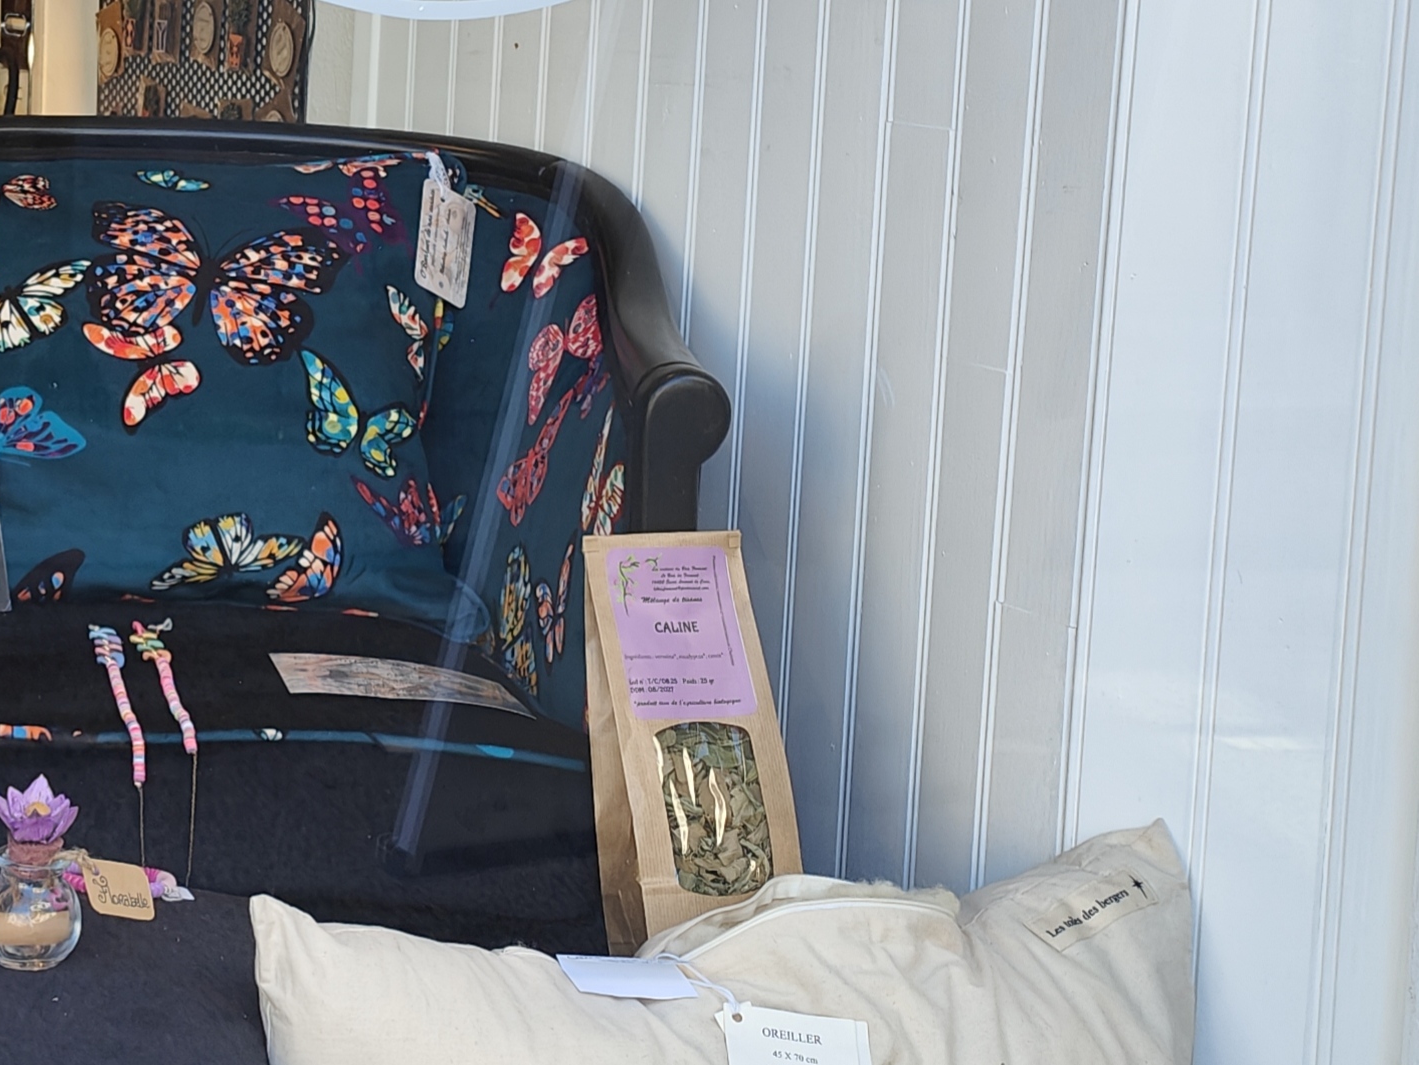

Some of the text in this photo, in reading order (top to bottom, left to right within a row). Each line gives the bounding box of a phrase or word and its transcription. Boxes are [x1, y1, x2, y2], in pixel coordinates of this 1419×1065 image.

[655, 621, 699, 633] CALINE
[1046, 926, 1065, 937] Les
[1082, 906, 1099, 920] des
[762, 1027, 823, 1045] OREILLER
[772, 1050, 818, 1065] 45 X 70 cm
